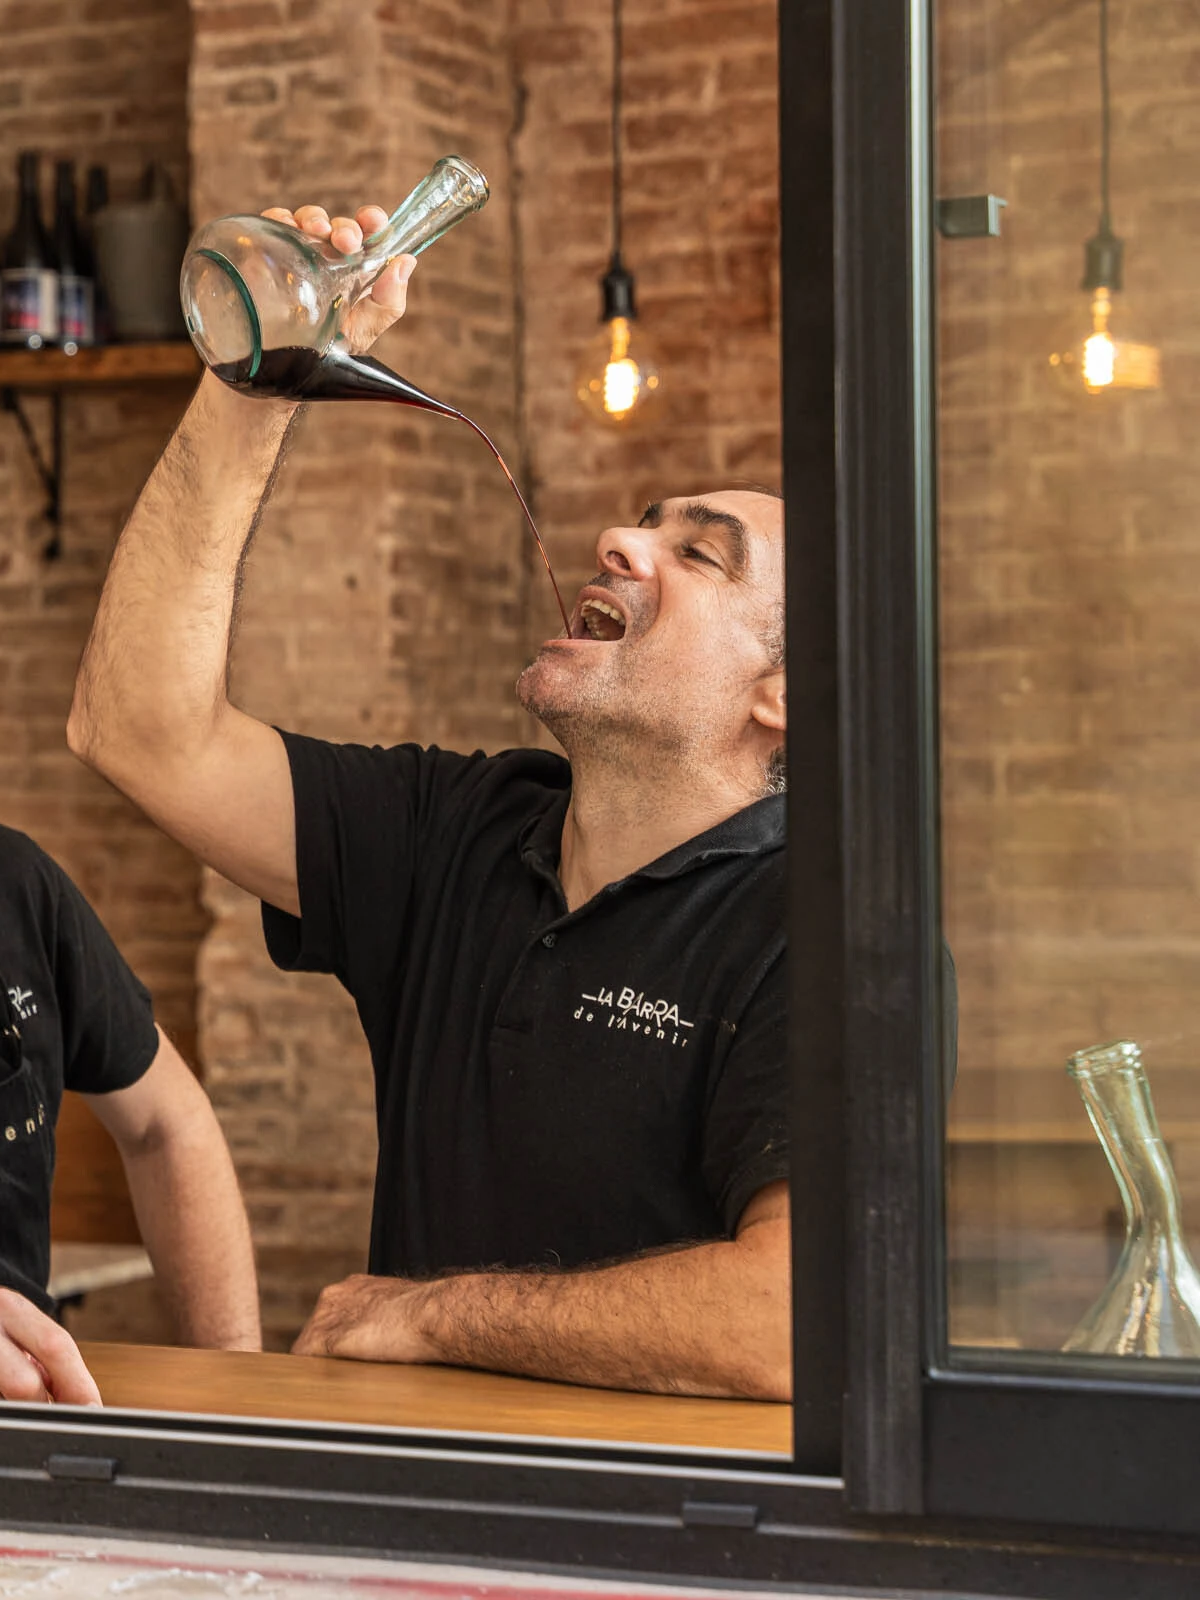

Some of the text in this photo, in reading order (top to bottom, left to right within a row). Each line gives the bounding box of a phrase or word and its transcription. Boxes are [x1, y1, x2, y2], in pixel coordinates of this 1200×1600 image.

[573, 1006, 688, 1048] de l'Avenir
[598, 986, 680, 1028] LA BARRA
